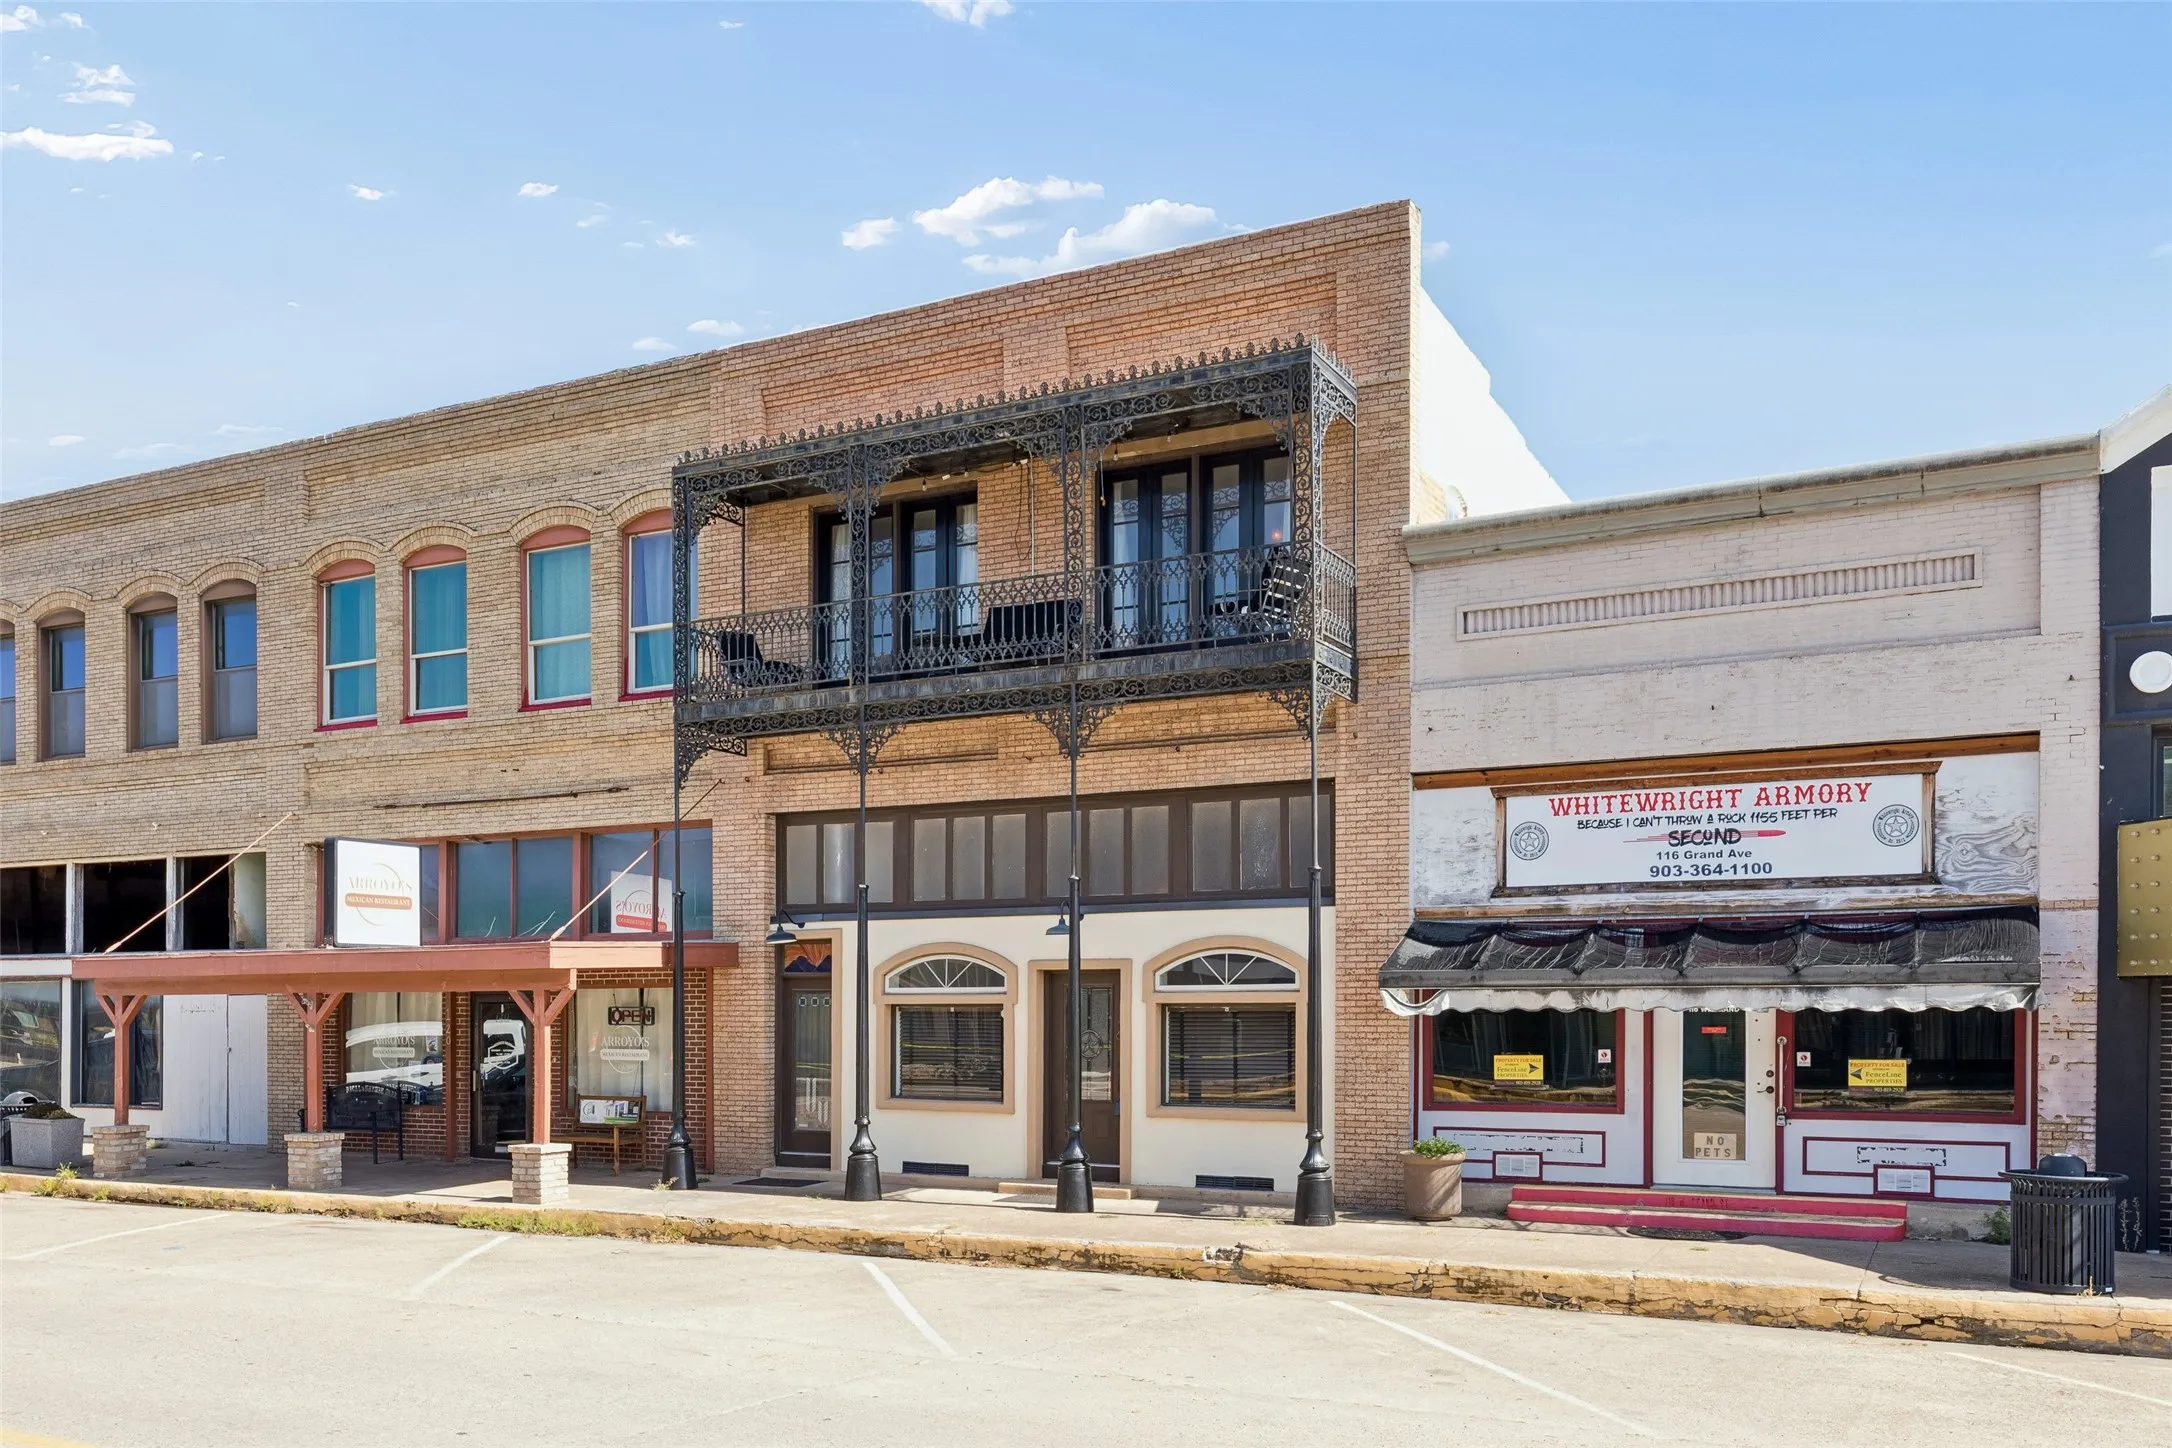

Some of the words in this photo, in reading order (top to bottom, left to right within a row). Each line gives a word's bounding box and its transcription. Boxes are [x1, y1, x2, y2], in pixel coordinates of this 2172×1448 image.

[1549, 788, 1743, 817] WHITEWRIGHT
[1754, 781, 1873, 807] ARMORY
[1577, 818, 1623, 830] BECAUSE
[1626, 819, 1630, 828] I
[1633, 815, 1663, 828] CAN'T
[1665, 814, 1703, 826] THROW
[1706, 814, 1715, 825] A
[1718, 813, 1746, 824] ROCK
[1750, 811, 1778, 824] 1155
[1781, 809, 1811, 821] FEET
[1813, 807, 1838, 819] PER
[1668, 827, 1742, 848] SECOND
[1656, 850, 1680, 861] 116
[1683, 849, 1723, 860] Grand
[1728, 848, 1753, 859] Ave
[1649, 862, 1773, 878] 903-364-1100
[346, 895, 374, 904] MEXICAN
[374, 897, 411, 906] RESTAURANT
[611, 1009, 651, 1023] OPEN
[600, 1036, 650, 1047] ARROYO'S
[1706, 1135, 1725, 1146] NO
[1695, 1147, 1731, 1158] PETS
